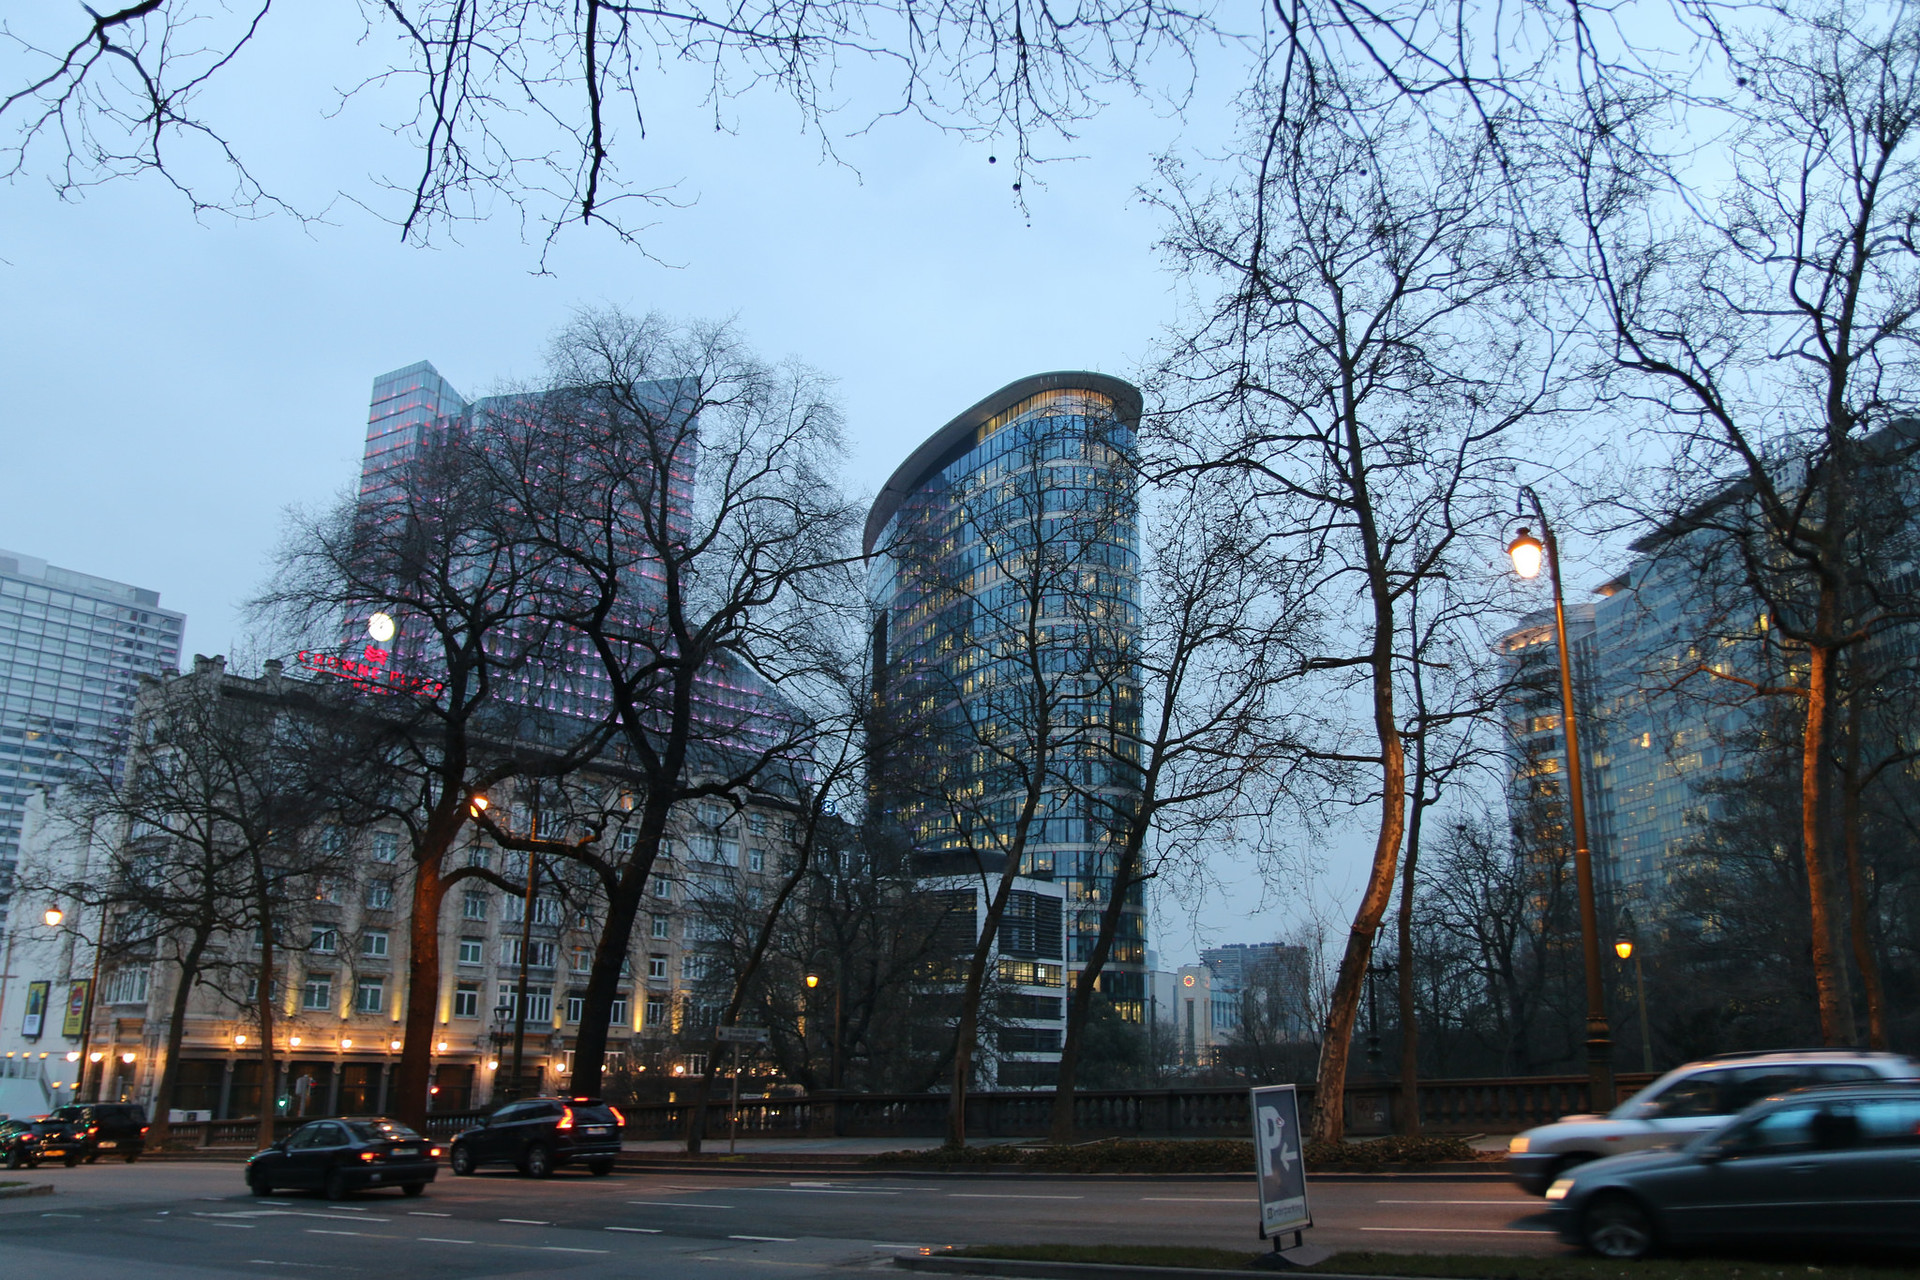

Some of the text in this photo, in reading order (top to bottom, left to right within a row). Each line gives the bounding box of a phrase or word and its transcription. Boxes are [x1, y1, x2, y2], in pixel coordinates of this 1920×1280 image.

[298, 650, 443, 693] CROWNE PLAZA
[1258, 1106, 1282, 1177] P
